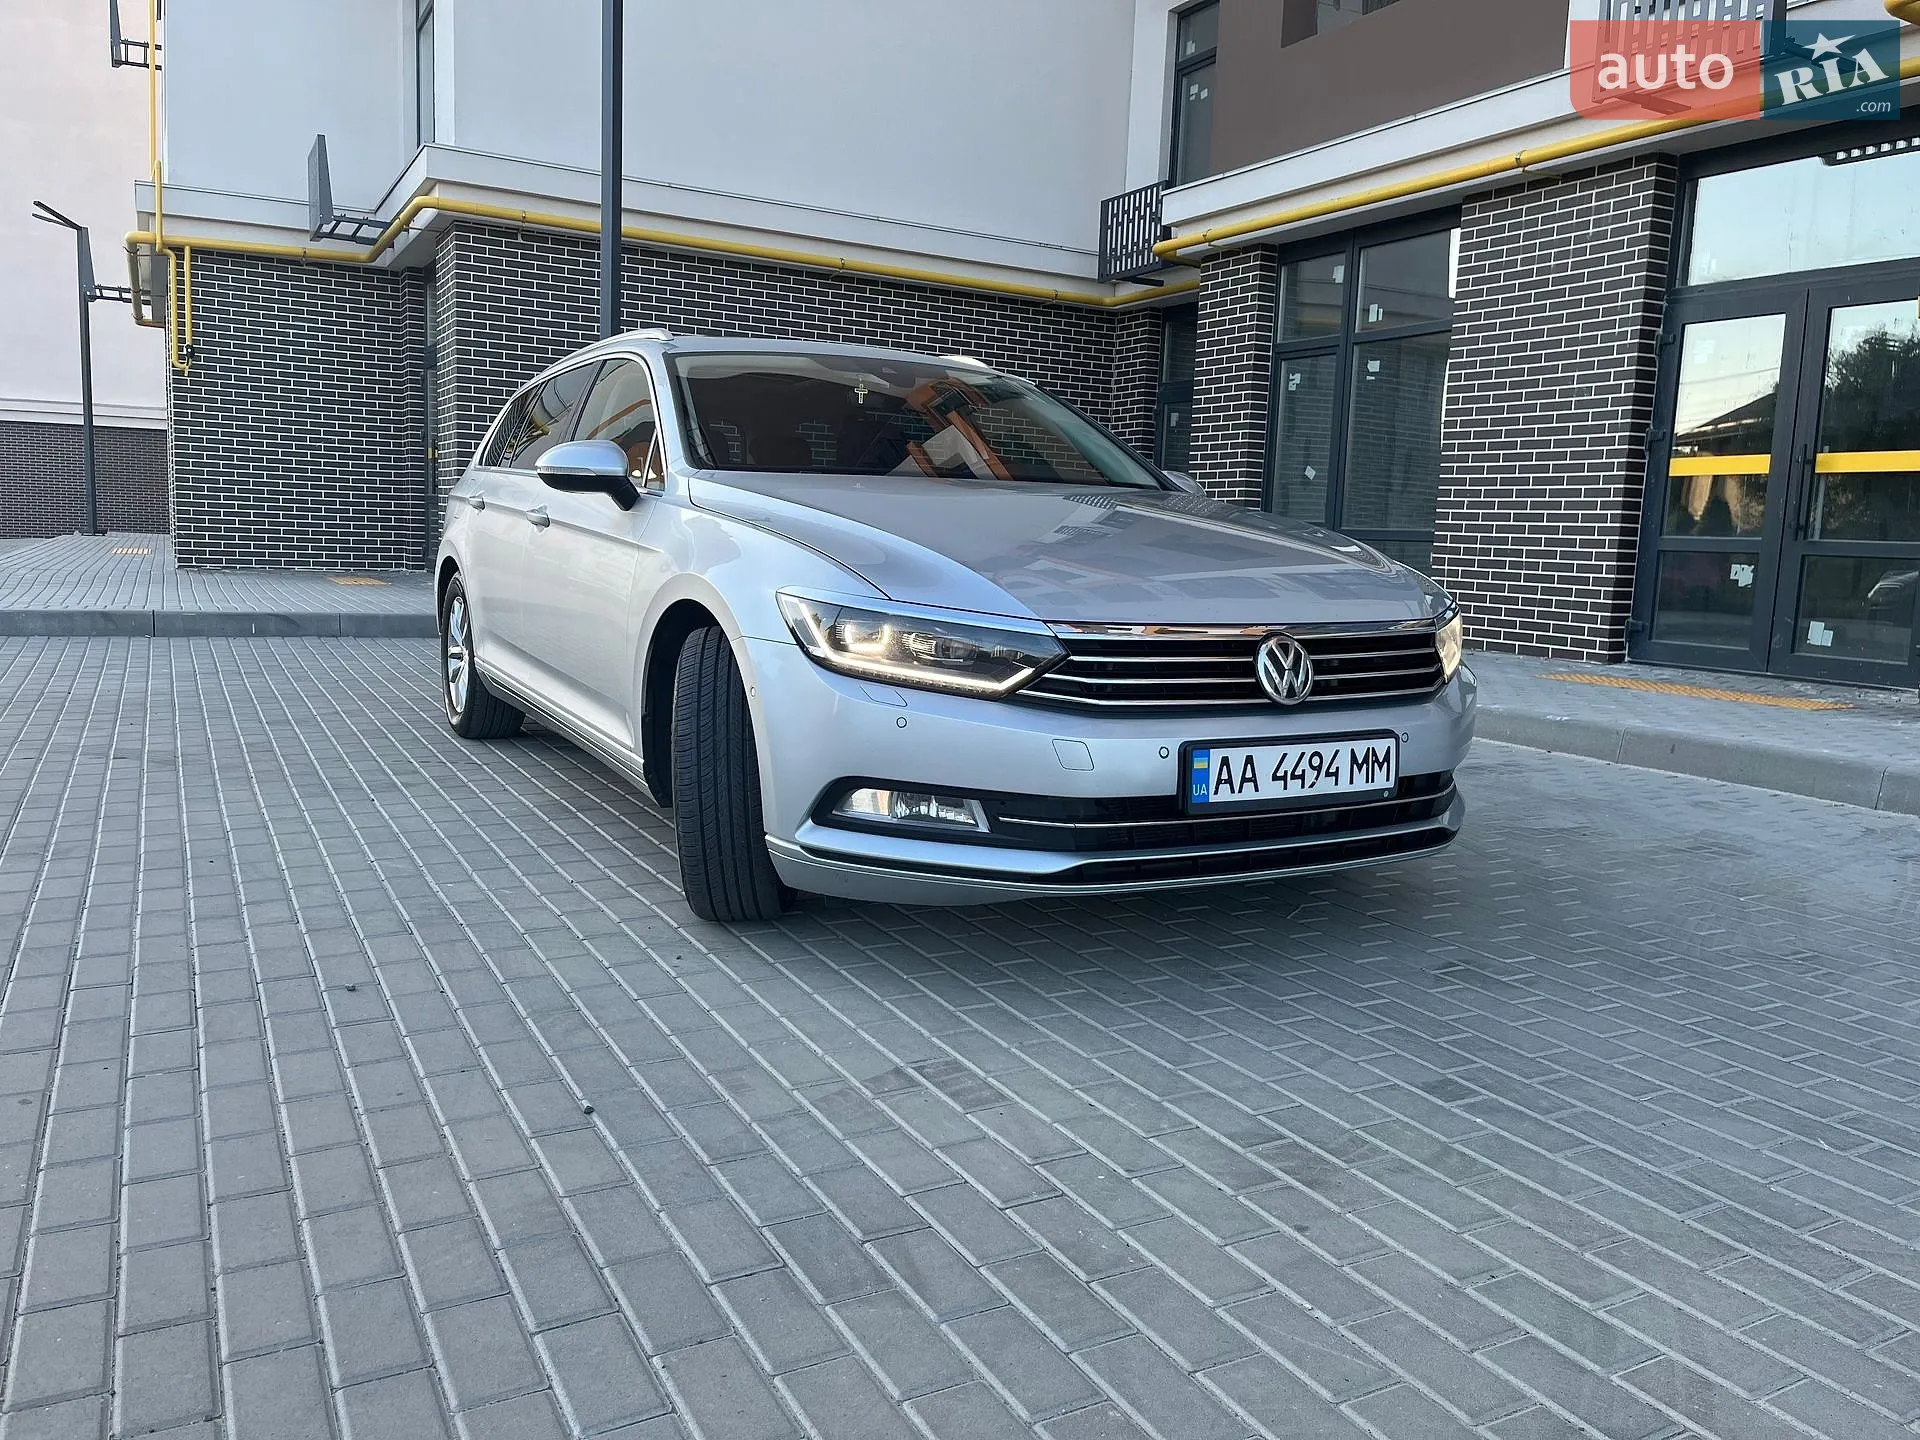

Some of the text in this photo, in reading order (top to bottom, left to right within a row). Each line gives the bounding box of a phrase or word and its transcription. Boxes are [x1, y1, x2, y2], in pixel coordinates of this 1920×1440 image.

[1213, 746, 1391, 795] AA 4494 MM
[1193, 784, 1208, 796] UA
